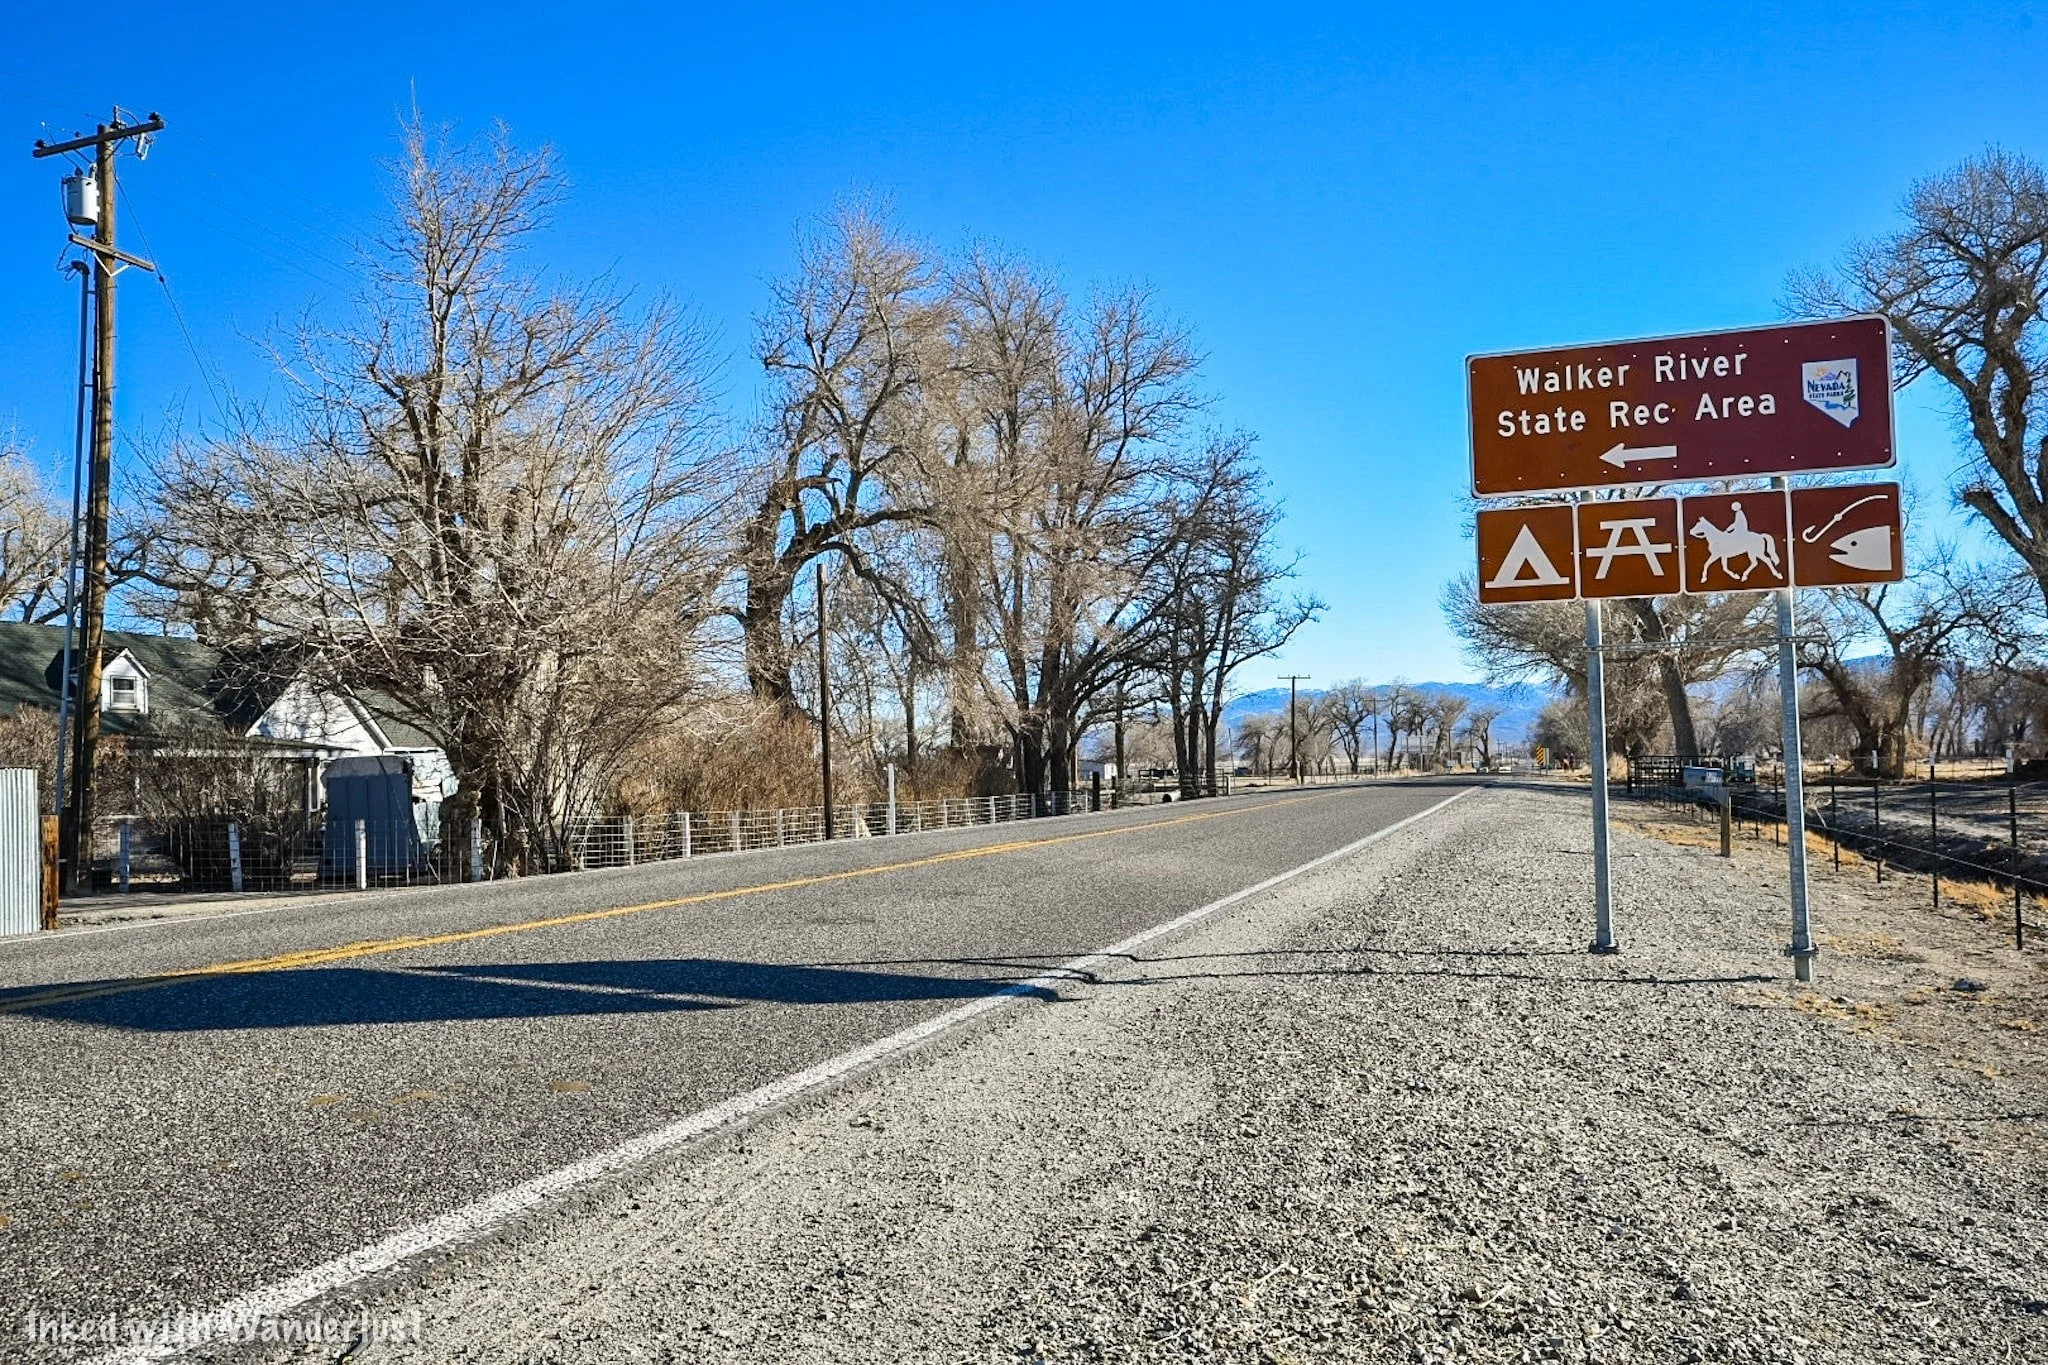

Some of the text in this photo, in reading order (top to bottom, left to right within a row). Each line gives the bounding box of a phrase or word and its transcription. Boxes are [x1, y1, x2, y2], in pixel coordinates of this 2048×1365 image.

[1516, 352, 1748, 396] Walker River
[1497, 392, 1777, 438] State Rec Area
